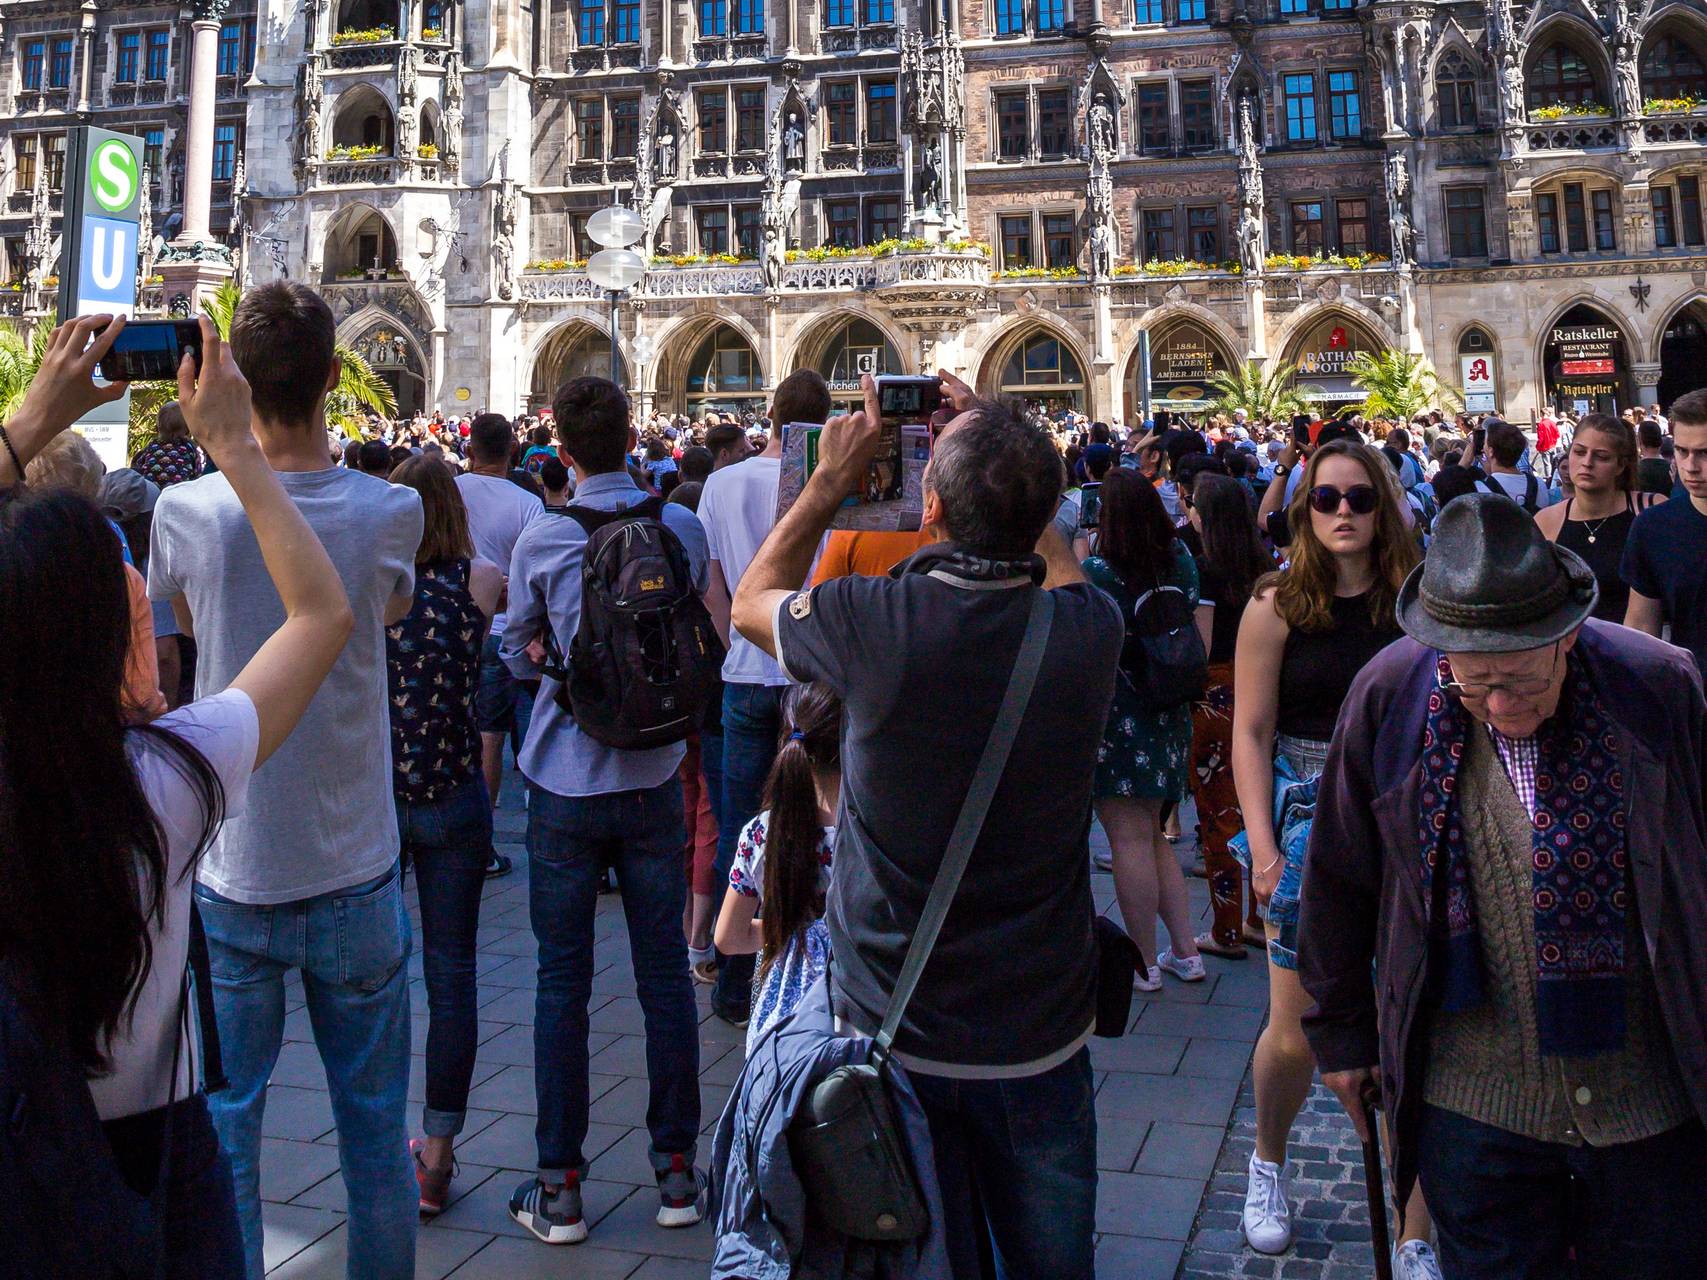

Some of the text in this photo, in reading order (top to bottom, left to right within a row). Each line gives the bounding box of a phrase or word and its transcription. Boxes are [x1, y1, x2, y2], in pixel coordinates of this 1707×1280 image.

[97, 144, 131, 207] S
[92, 226, 126, 291] U
[1552, 327, 1619, 341] Ratskeller
[1562, 343, 1610, 352] RESTAURANT
[1306, 351, 1369, 362] RATHA
[1156, 371, 1187, 379] AMBER
[825, 382, 859, 390] ünchen
